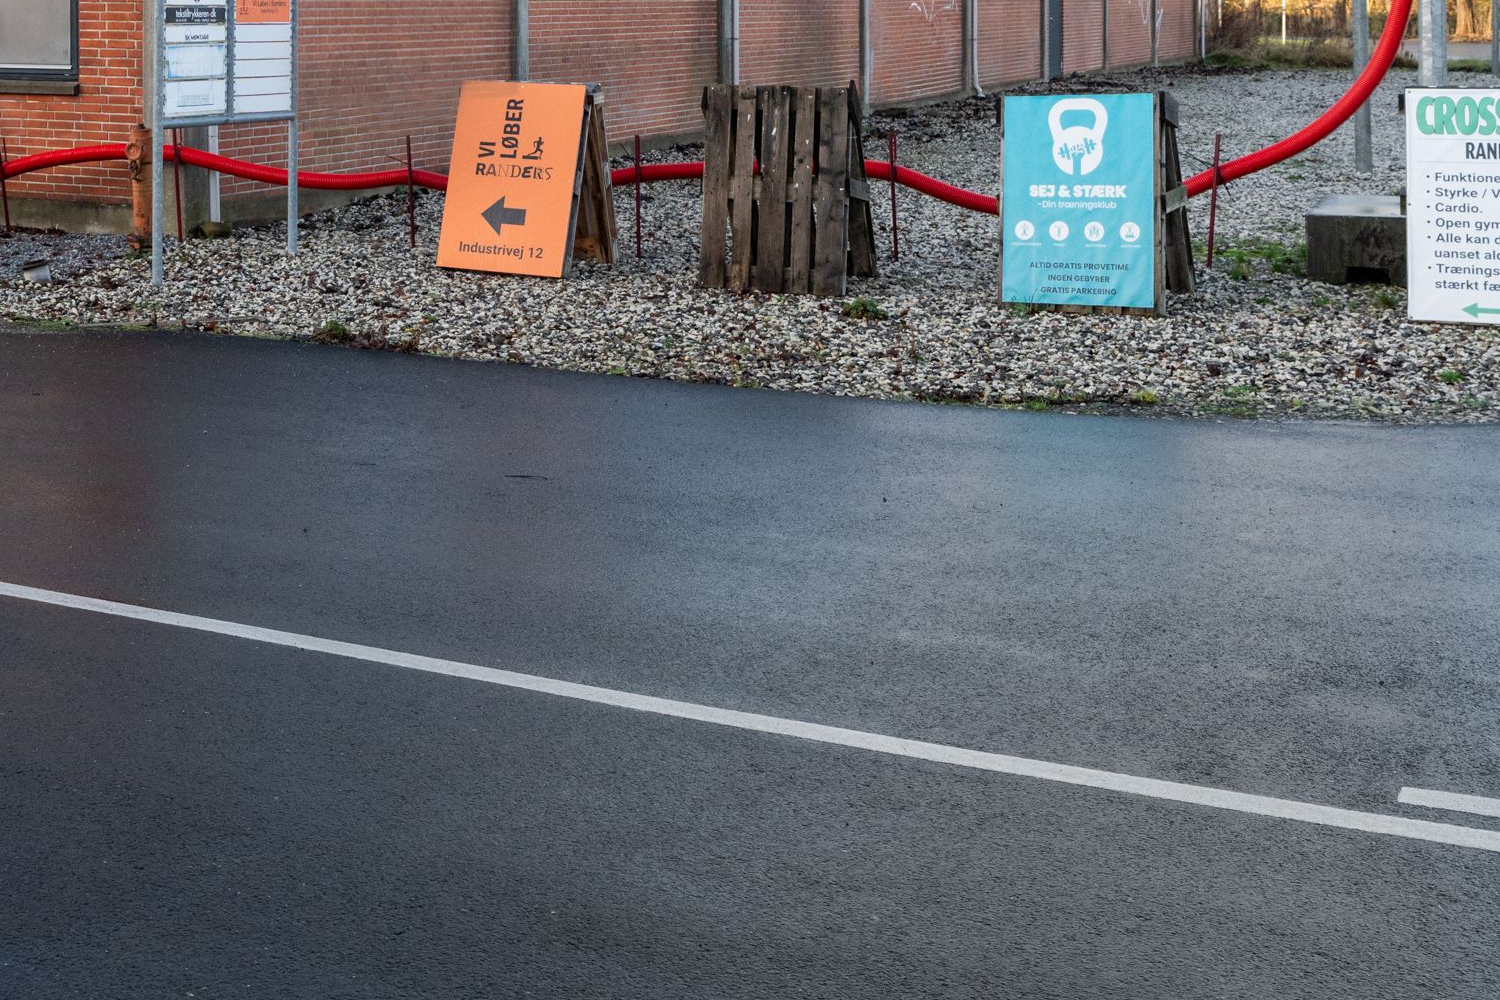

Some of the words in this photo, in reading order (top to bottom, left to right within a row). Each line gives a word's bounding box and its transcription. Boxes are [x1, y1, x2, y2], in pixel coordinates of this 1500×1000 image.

[1416, 96, 1500, 135] CROS
[500, 99, 524, 158] LØBER
[478, 141, 496, 158] VI
[1465, 142, 1500, 160] RAN
[476, 163, 553, 180] RANDERS
[1029, 184, 1055, 198] SEJ
[1058, 184, 1071, 198] &
[1073, 184, 1127, 198] STÆRK
[1435, 187, 1478, 200] Styrke
[1058, 200, 1117, 211] træningsklub
[1435, 202, 1483, 213] Cardio.
[1435, 217, 1470, 230] Open
[1436, 233, 1462, 243] Alle
[1466, 233, 1490, 244] kan
[459, 240, 524, 260] Industrivej
[528, 247, 544, 259] 12
[1434, 250, 1480, 260] uanset
[1053, 262, 1082, 270] GRATIS
[1083, 263, 1130, 271] PRØVETIME
[1436, 263, 1500, 277] Trænings
[1047, 274, 1072, 282] INGEN
[1074, 275, 1110, 283] GEBYRER
[1435, 280, 1479, 290] stærkt
[1040, 286, 1069, 294] GRATIS
[1071, 287, 1117, 296] PARKERING
